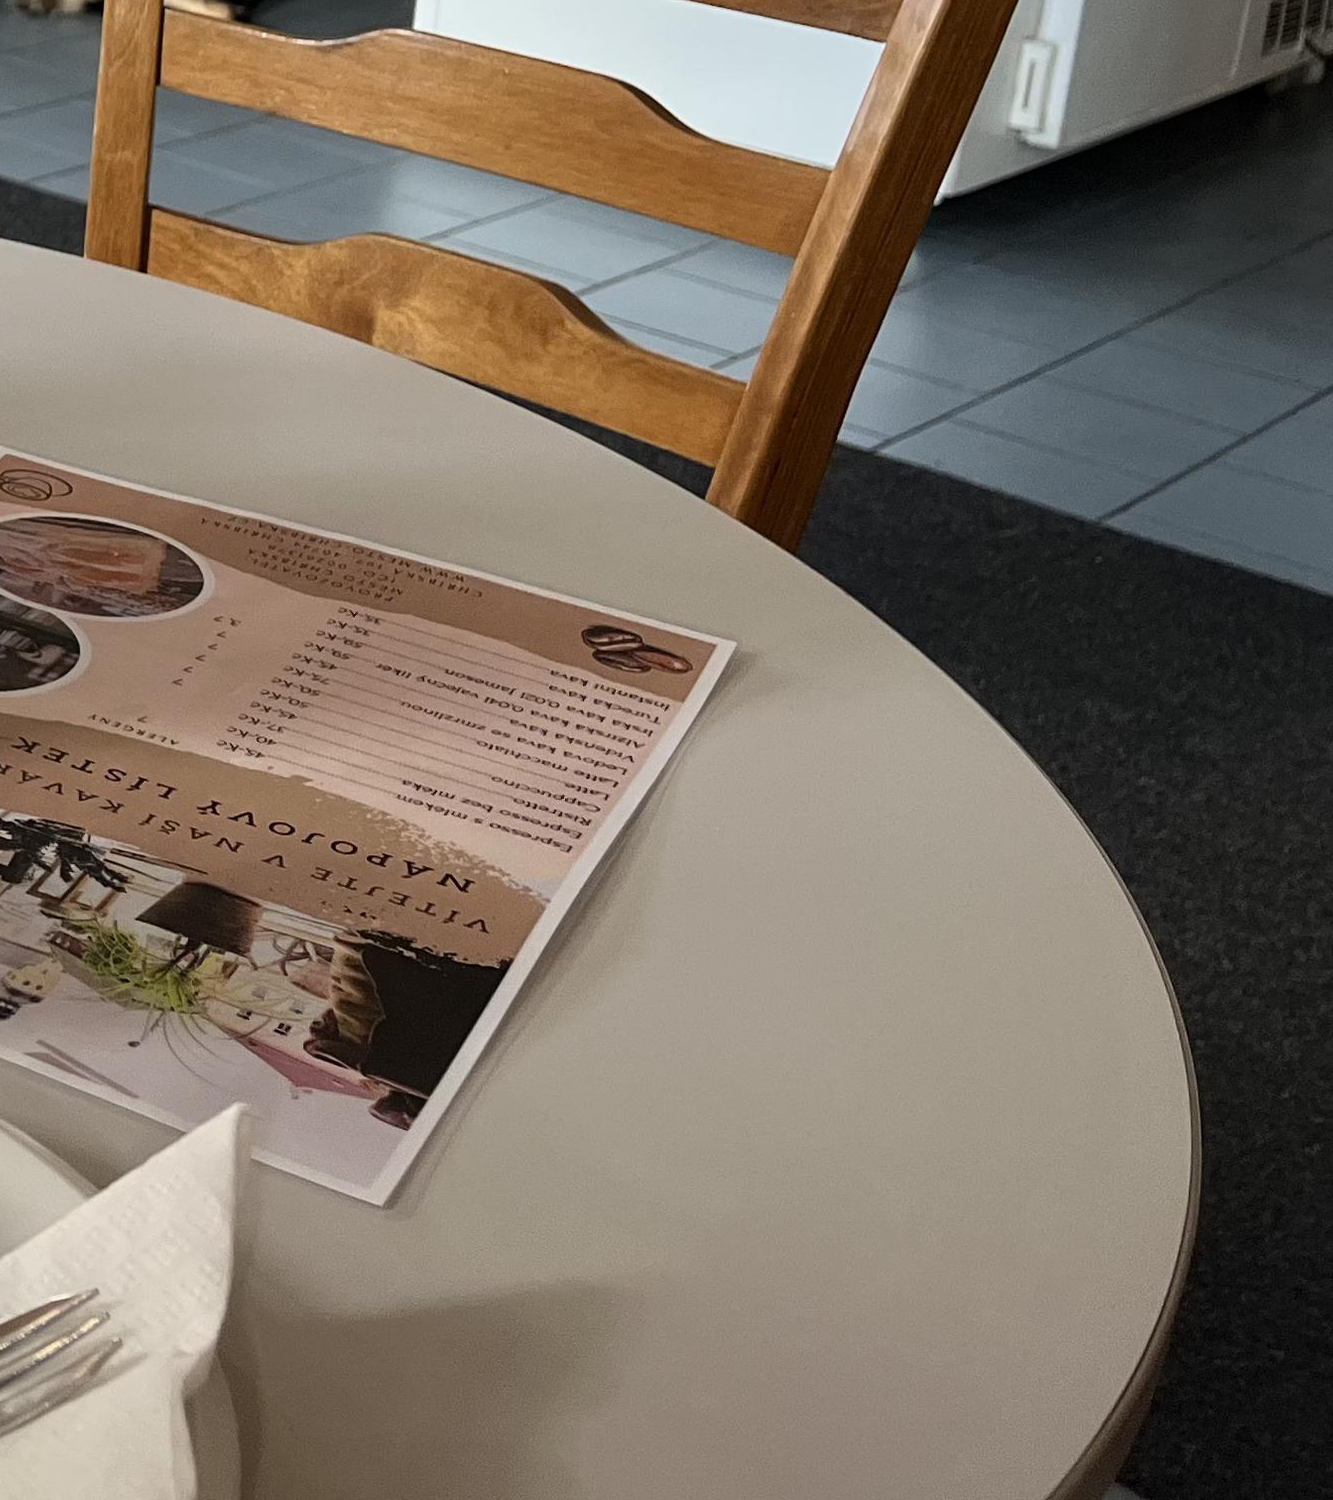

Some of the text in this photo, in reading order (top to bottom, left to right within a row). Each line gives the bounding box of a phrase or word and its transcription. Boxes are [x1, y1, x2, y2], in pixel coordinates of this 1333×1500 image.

[87, 713, 179, 745] ALERGENY
[476, 740, 619, 788] Latte macchiato
[461, 798, 494, 813] bez
[491, 776, 601, 813] Cappuccino
[564, 782, 610, 801] Latte
[10, 736, 476, 894] NÁPOJOVÝ LÍSTEK
[498, 809, 583, 840] Espresso
[513, 798, 592, 827] Ristretto
[138, 813, 245, 853] NAŠÍ
[489, 822, 574, 853] Espresso
[261, 855, 286, 869] V
[310, 866, 489, 934] VÍTEJTE
